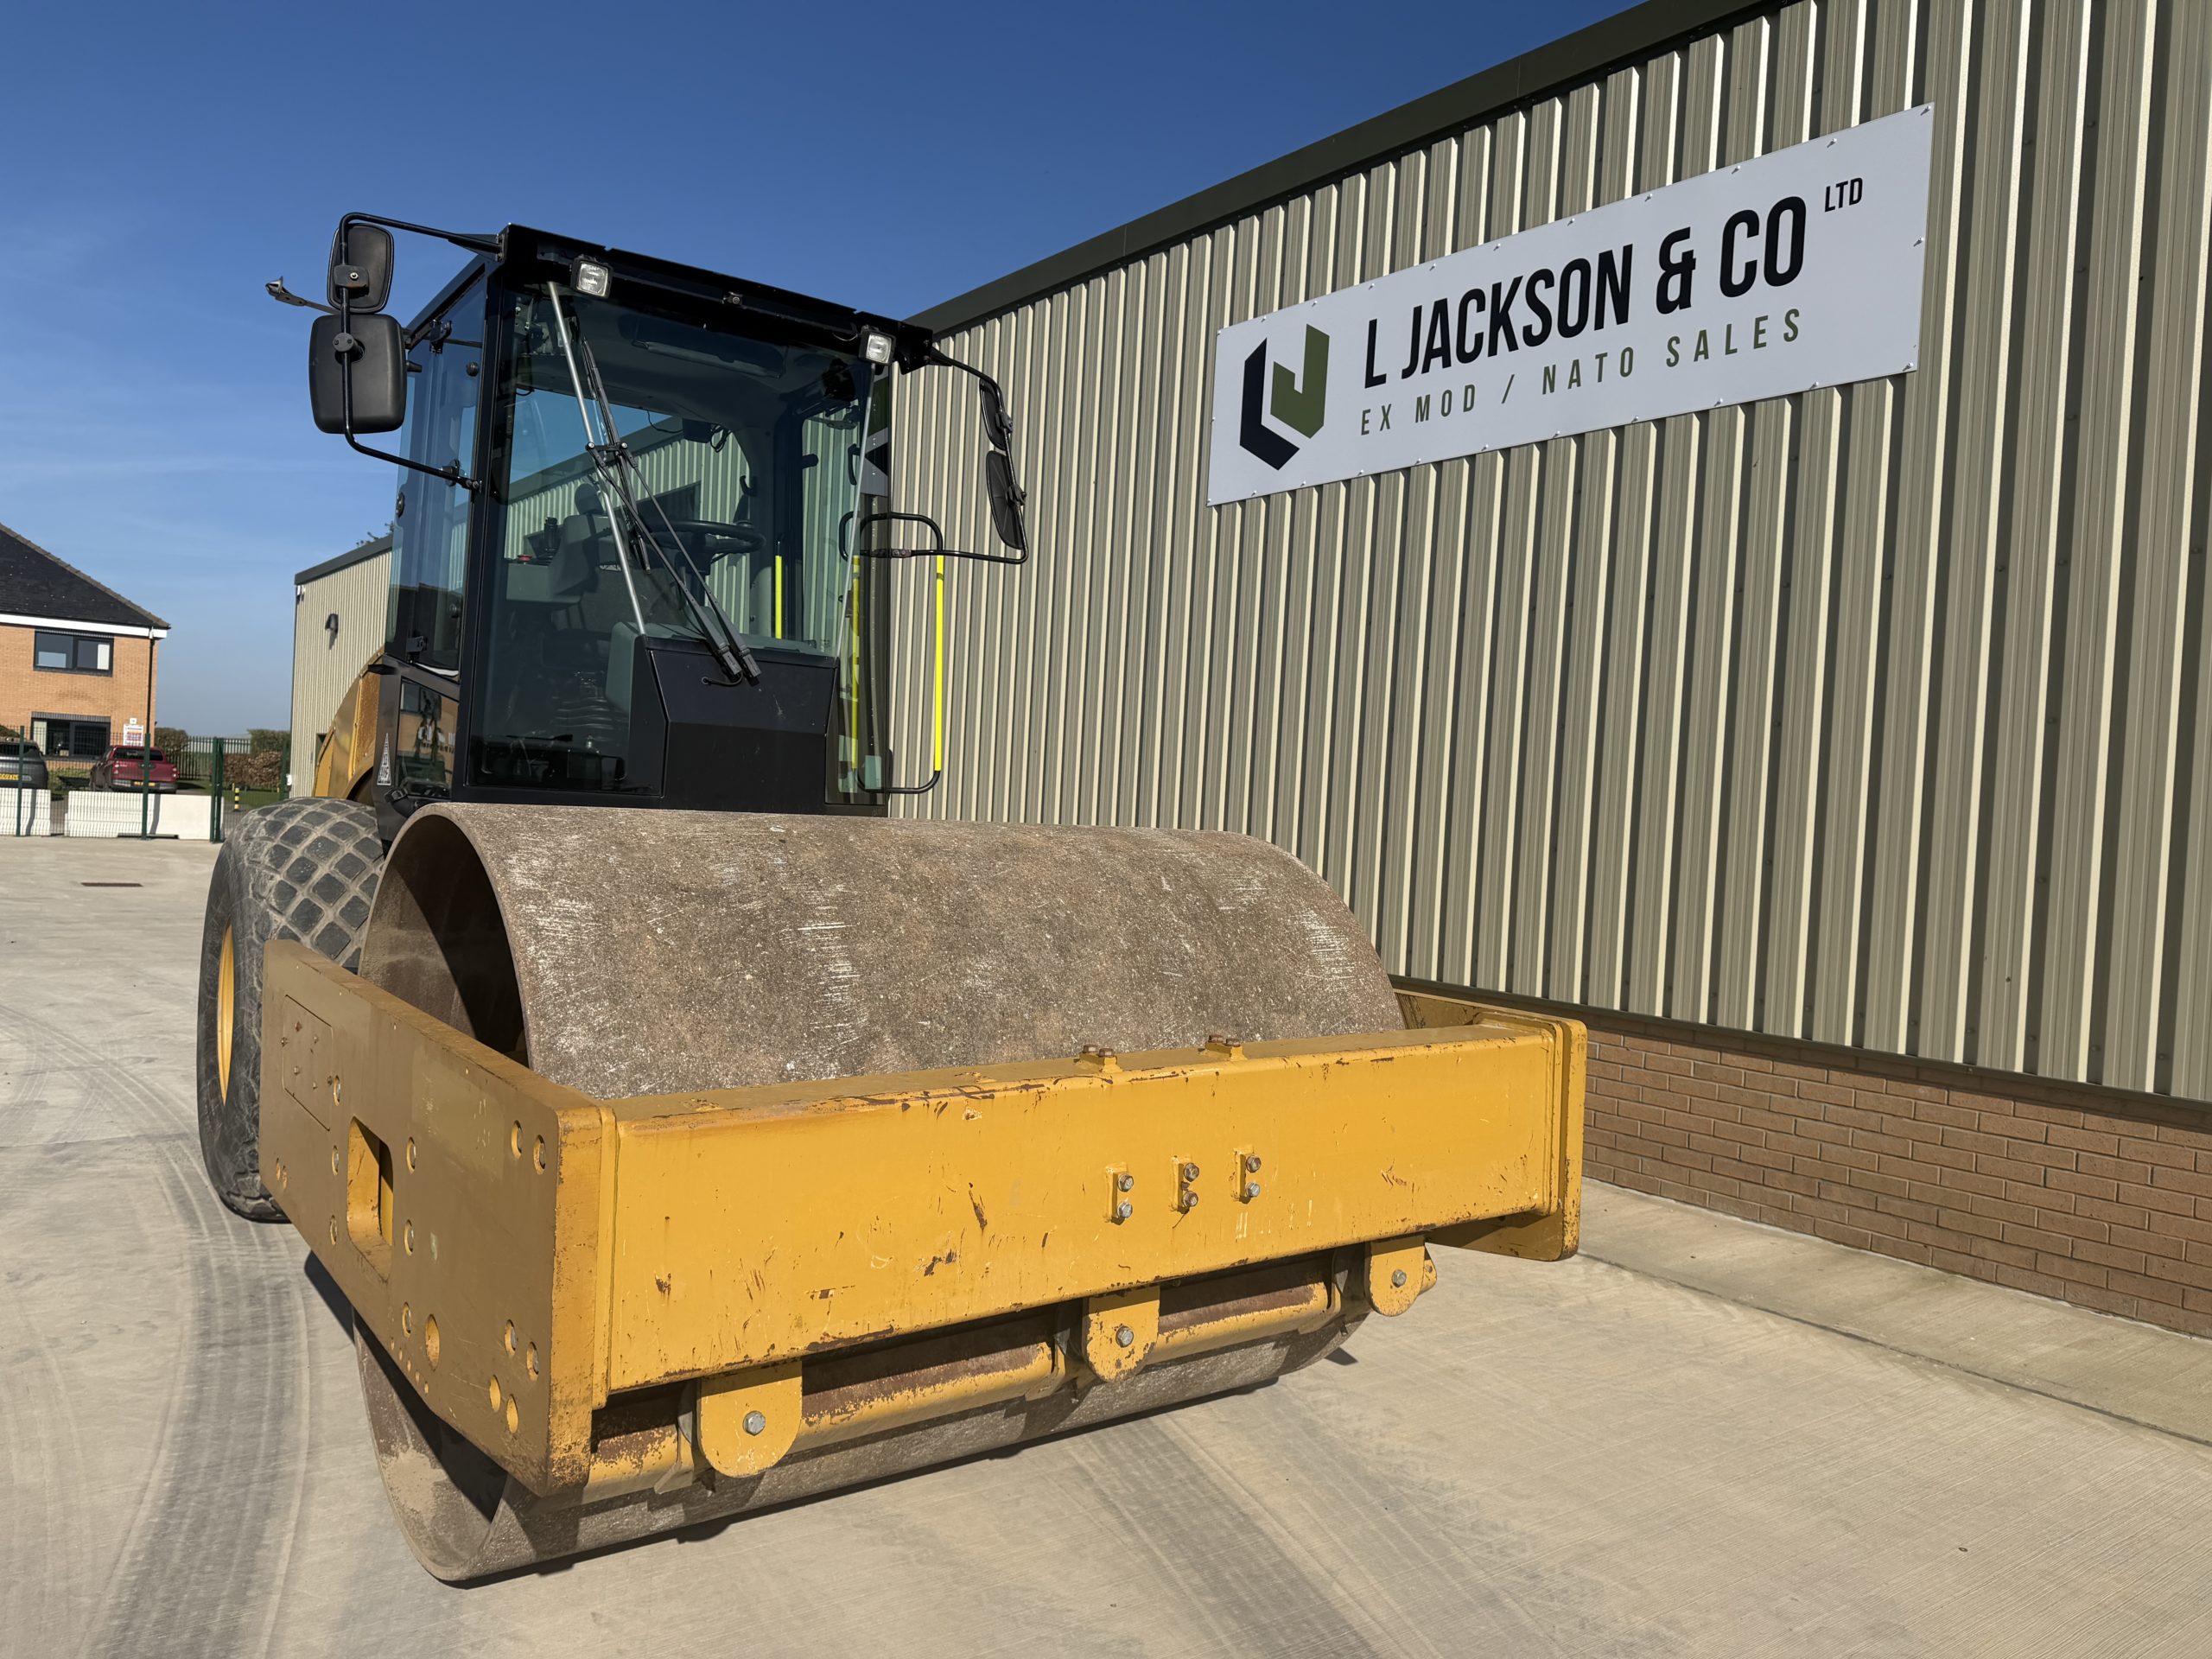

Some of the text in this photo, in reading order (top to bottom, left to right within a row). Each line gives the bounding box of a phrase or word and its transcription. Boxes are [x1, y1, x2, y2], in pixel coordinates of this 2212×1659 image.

[1363, 177, 1864, 390] L JACKSON & CO LTD
[1361, 308, 1800, 436] EX MOD / NATO SALES
